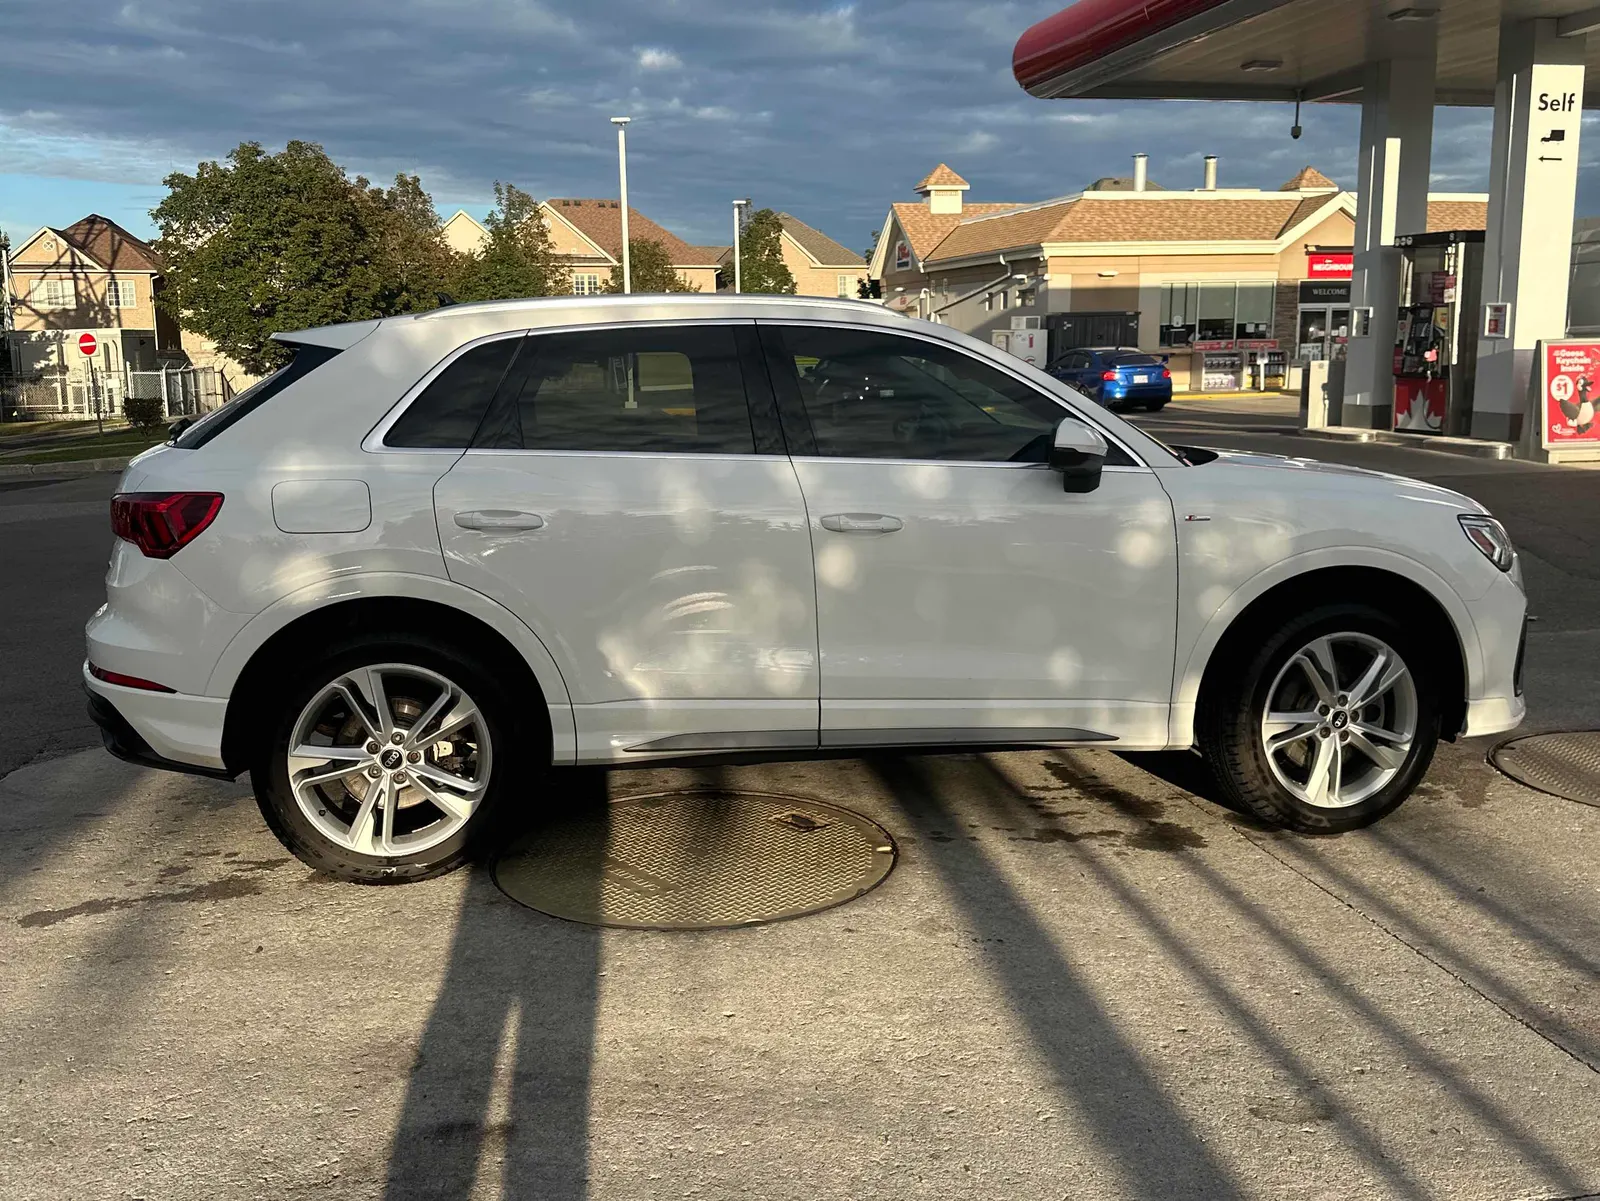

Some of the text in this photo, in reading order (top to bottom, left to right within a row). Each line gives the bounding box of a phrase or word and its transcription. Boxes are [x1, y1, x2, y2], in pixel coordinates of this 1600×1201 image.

[1538, 93, 1575, 112] Self
[1312, 288, 1347, 296] WELCOME
[1556, 356, 1591, 365] Keychain
[1561, 364, 1584, 372] Inside
[1556, 382, 1568, 395] $1
